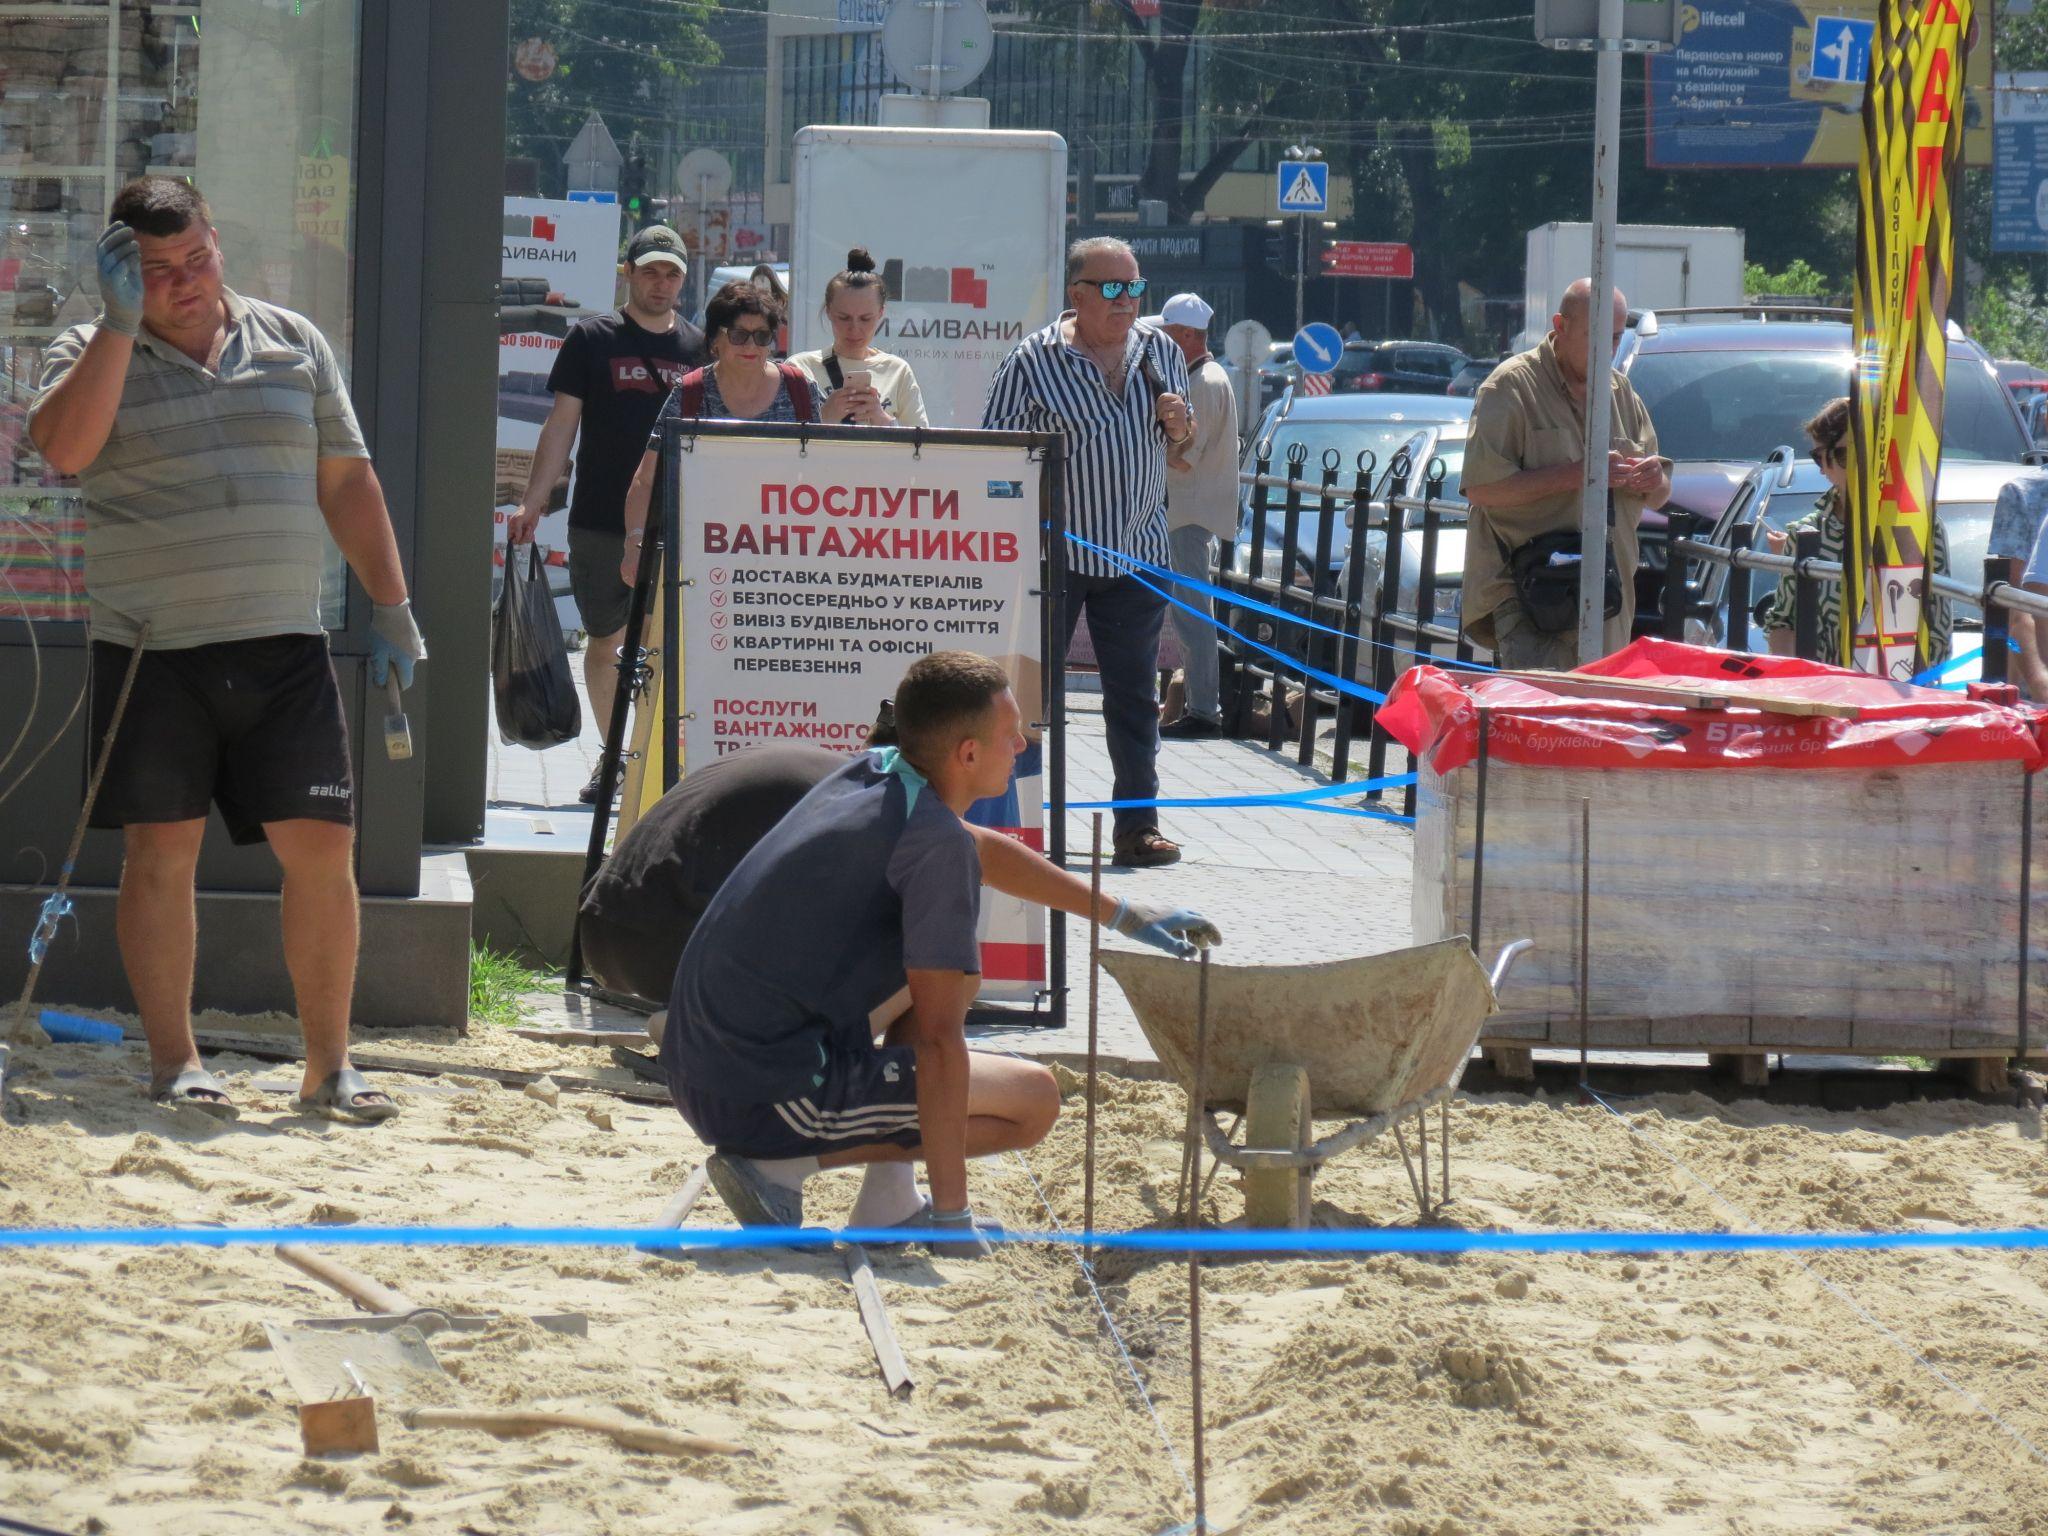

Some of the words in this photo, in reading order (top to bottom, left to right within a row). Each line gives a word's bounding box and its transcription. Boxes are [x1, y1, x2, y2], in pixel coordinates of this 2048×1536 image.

[1701, 11, 1745, 26] lifecell
[1676, 49, 1744, 63] Переносьте
[1746, 51, 1784, 63] номер
[1676, 67, 1690, 76] на
[1685, 81, 1745, 92] безлімітом
[898, 318, 1022, 340] ДИВАНИ
[520, 335, 542, 348] 900
[760, 484, 959, 520] ПОСЛУГИ
[704, 522, 1019, 563] ВАНТАЖНИКІВ
[732, 569, 832, 585] ДОСТАВКА
[837, 572, 983, 590] БУДМАТЕРІАЛІВ
[732, 591, 888, 610] БЕЗПОСЕРЕДНЬО
[893, 596, 905, 609] У
[910, 597, 1005, 613] КВАРТИРУ
[733, 614, 785, 628] ВИВІЗ
[791, 615, 928, 632] БУДІВЕЛЬНОГО
[934, 619, 999, 635] СМІТТЯ
[733, 636, 834, 652] КВАРТИРНІ
[839, 638, 863, 653] ТА
[868, 640, 933, 654] ОФІСНІ
[733, 658, 862, 675] ПЕРЕВЕЗЕННЯ
[713, 700, 817, 717] ПОСЛУГИ
[713, 720, 870, 739] ВАНТАЖНОГО
[309, 785, 351, 799] saller
